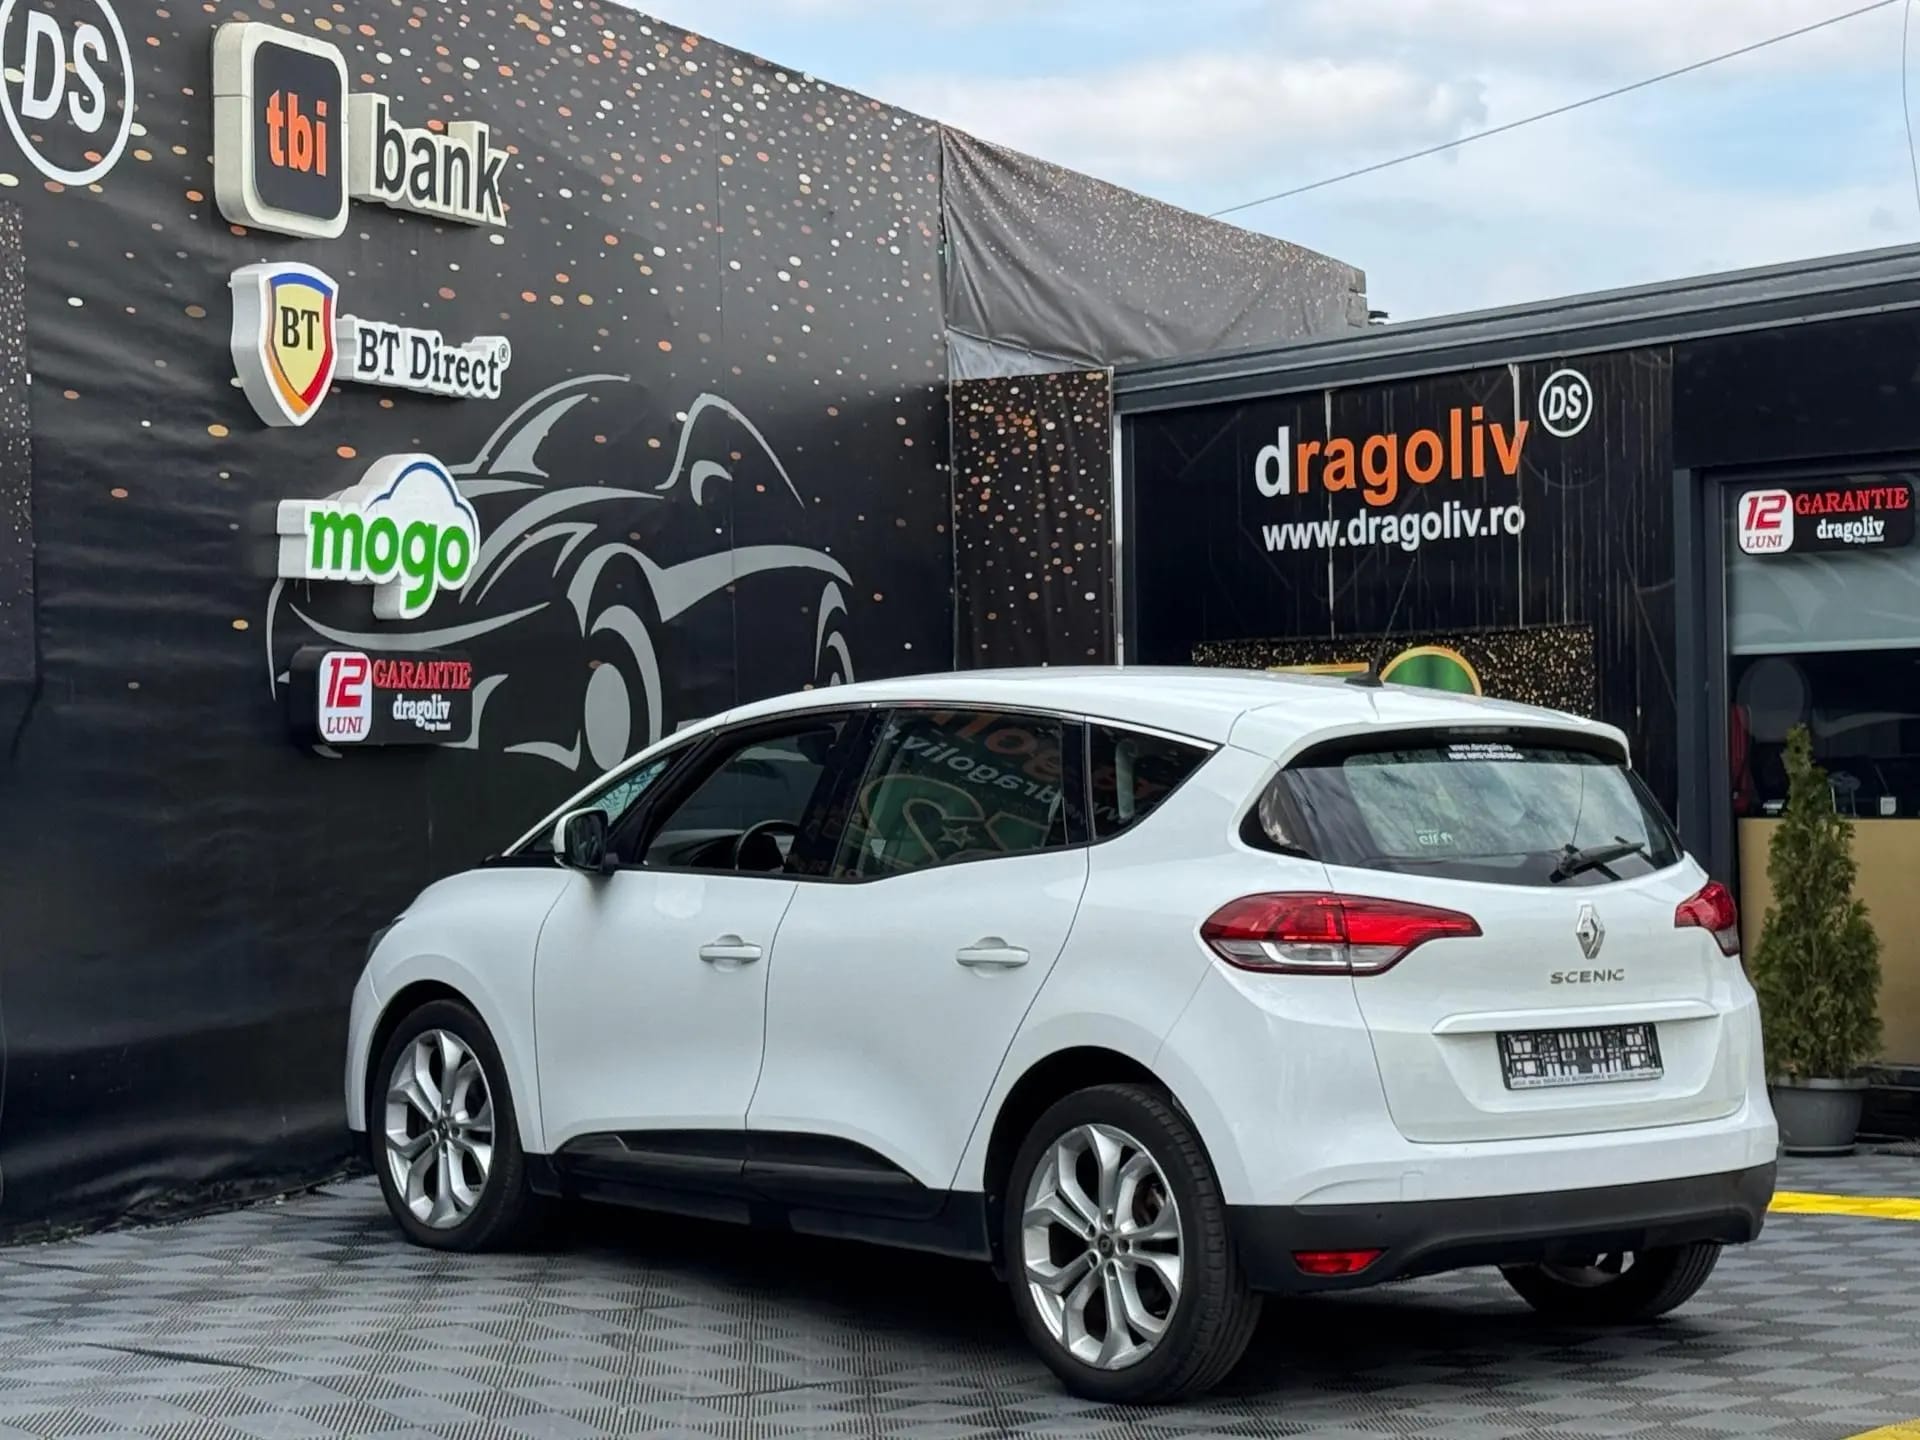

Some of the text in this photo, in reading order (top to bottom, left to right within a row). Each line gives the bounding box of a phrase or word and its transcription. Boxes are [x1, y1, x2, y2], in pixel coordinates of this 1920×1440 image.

[21, 9, 108, 133] DS
[265, 89, 503, 220] tbi bank
[281, 305, 320, 352] BT
[357, 326, 400, 376] BT
[1547, 383, 1583, 421] DS
[1254, 405, 1531, 507] dragoliv
[1262, 500, 1526, 552] www.dragoliv.ro
[1744, 487, 1910, 532] 12 GARANTIE
[1816, 515, 1885, 543] dragoliv
[310, 510, 471, 611] mogo
[1745, 535, 1784, 549] LUNI
[325, 658, 473, 708] 12 GARANTIE
[326, 716, 364, 735] LUNI
[392, 693, 452, 728] dragoliv
[1549, 968, 1625, 985] SCENIC
